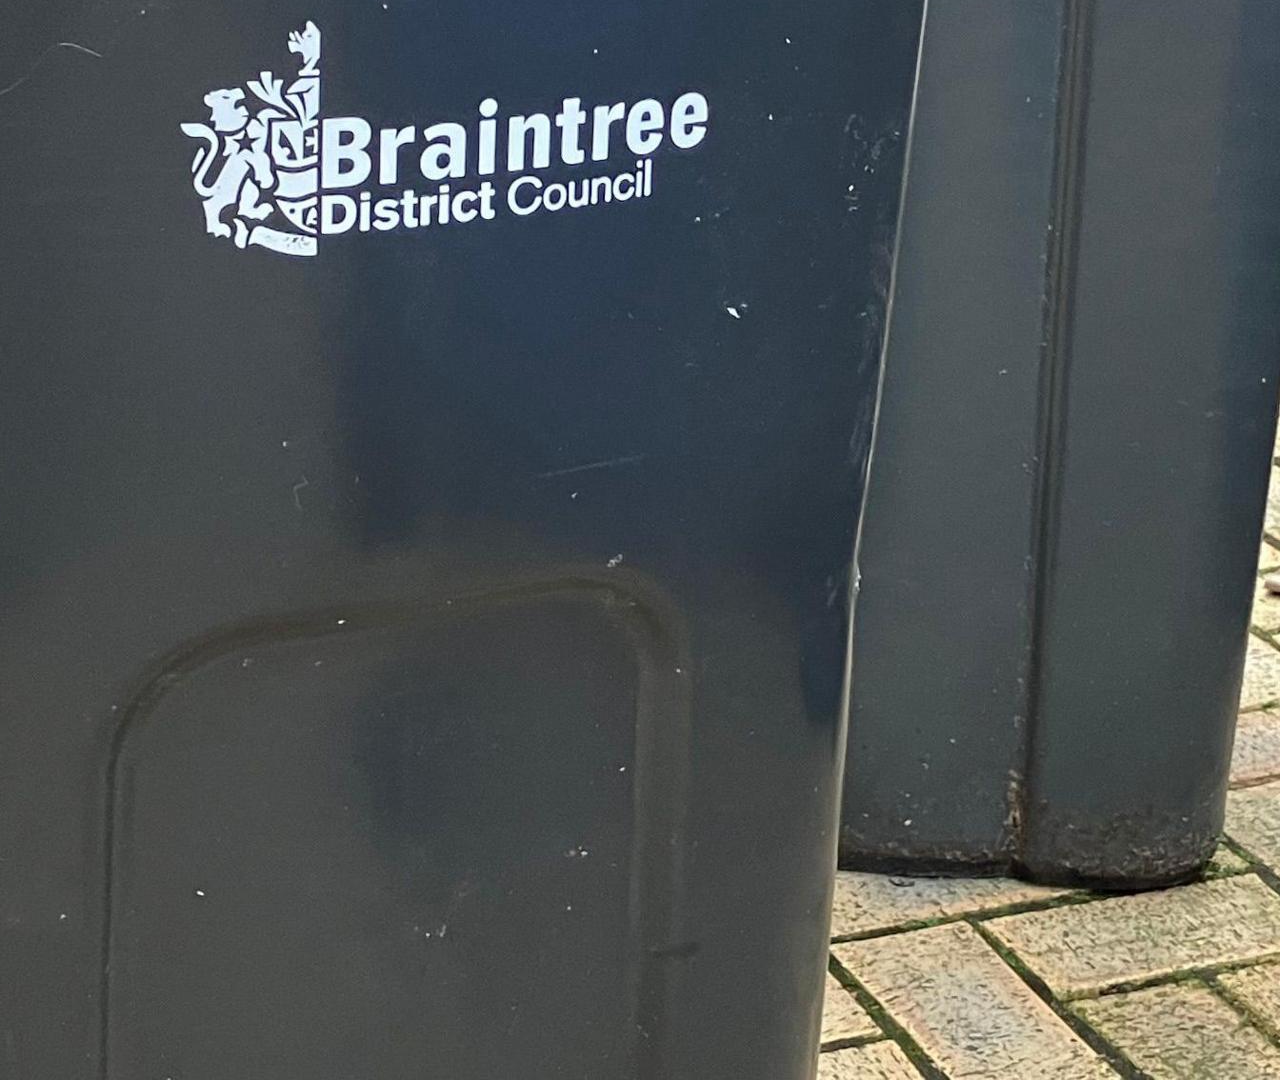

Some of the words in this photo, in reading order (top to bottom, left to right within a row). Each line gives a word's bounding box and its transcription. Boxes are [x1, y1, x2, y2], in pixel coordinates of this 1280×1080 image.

[320, 91, 710, 189] Braintree
[321, 181, 496, 234] District
[507, 161, 653, 216] Council
